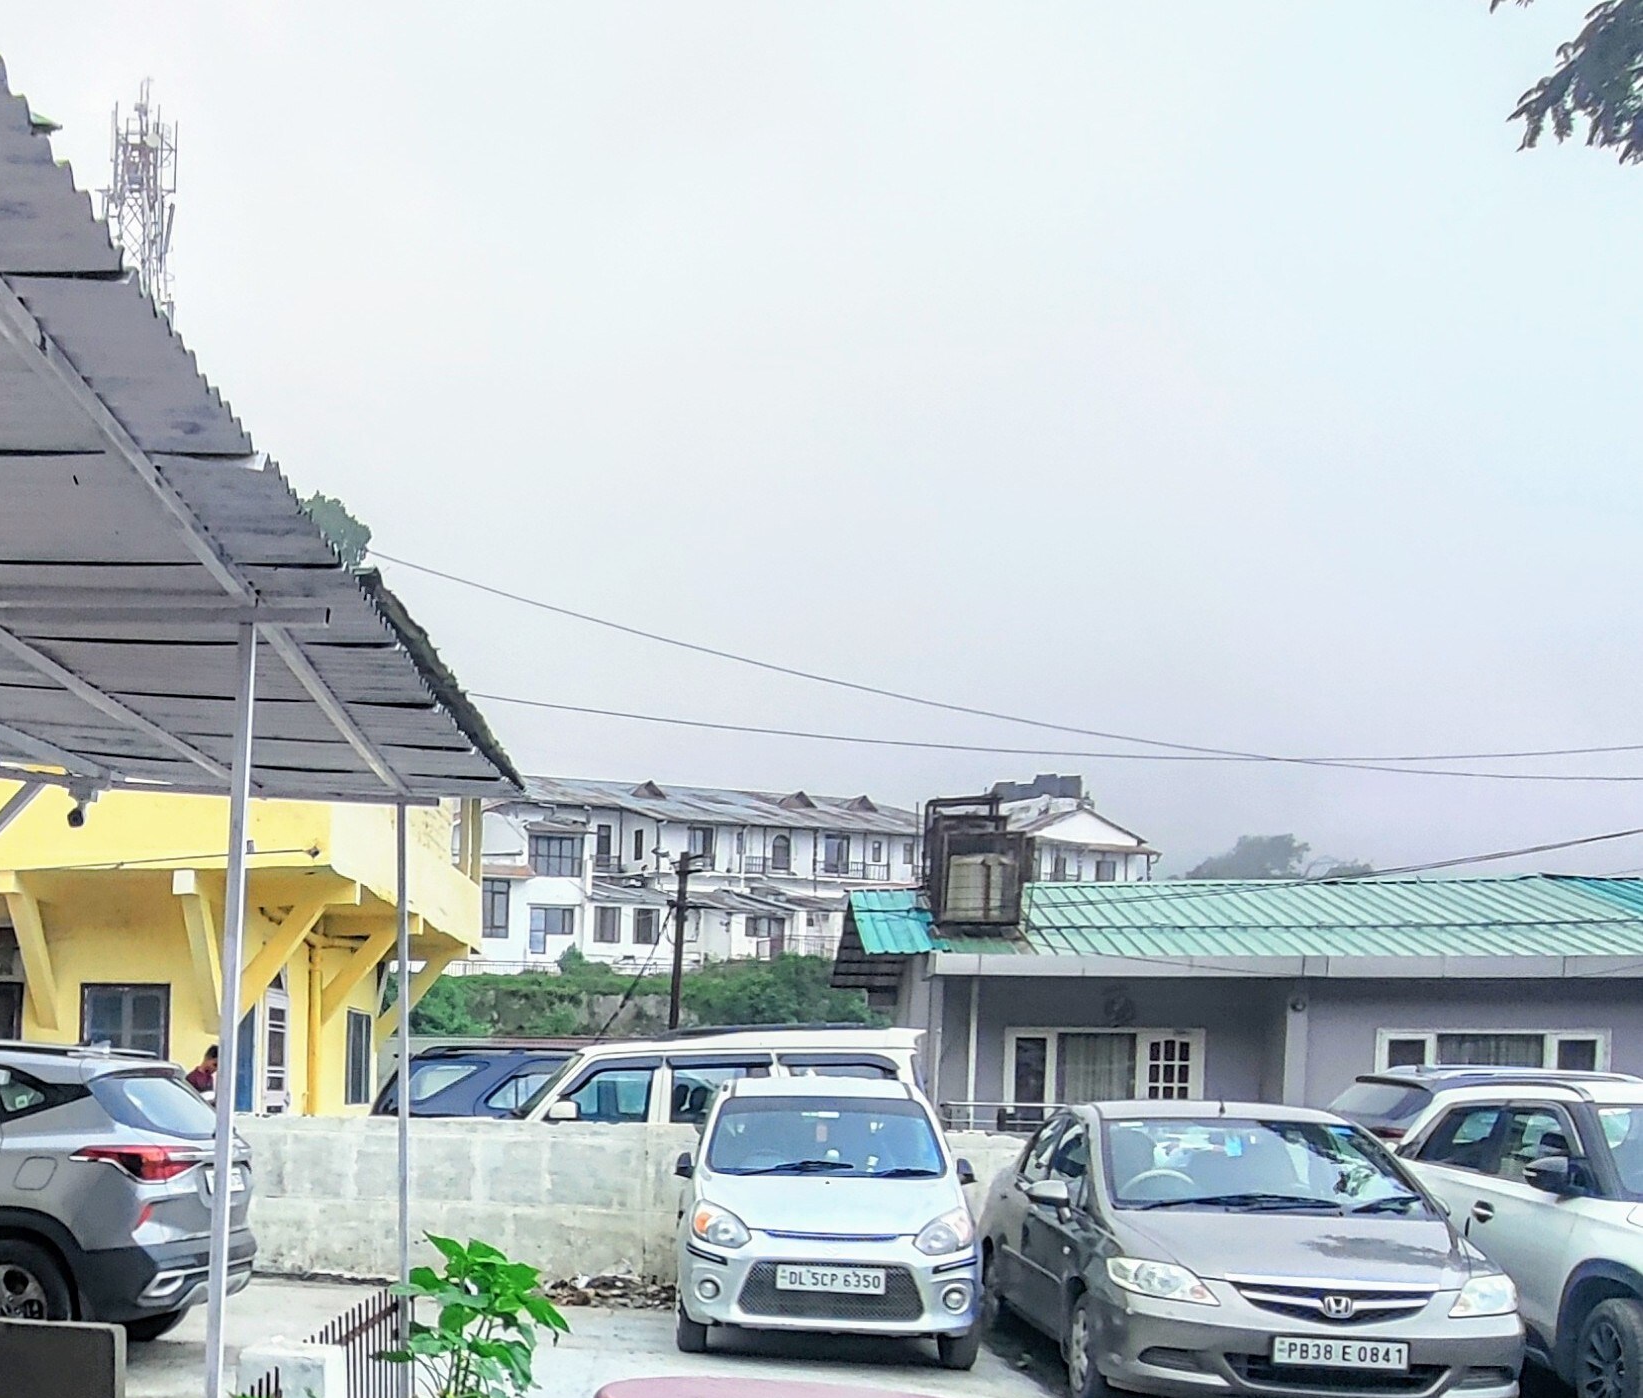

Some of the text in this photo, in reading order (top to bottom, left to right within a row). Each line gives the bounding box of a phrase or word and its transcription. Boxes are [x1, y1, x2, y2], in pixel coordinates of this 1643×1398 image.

[788, 1271, 881, 1289] DL 5CP 6350
[1287, 1342, 1403, 1365] PB38 E 0841
